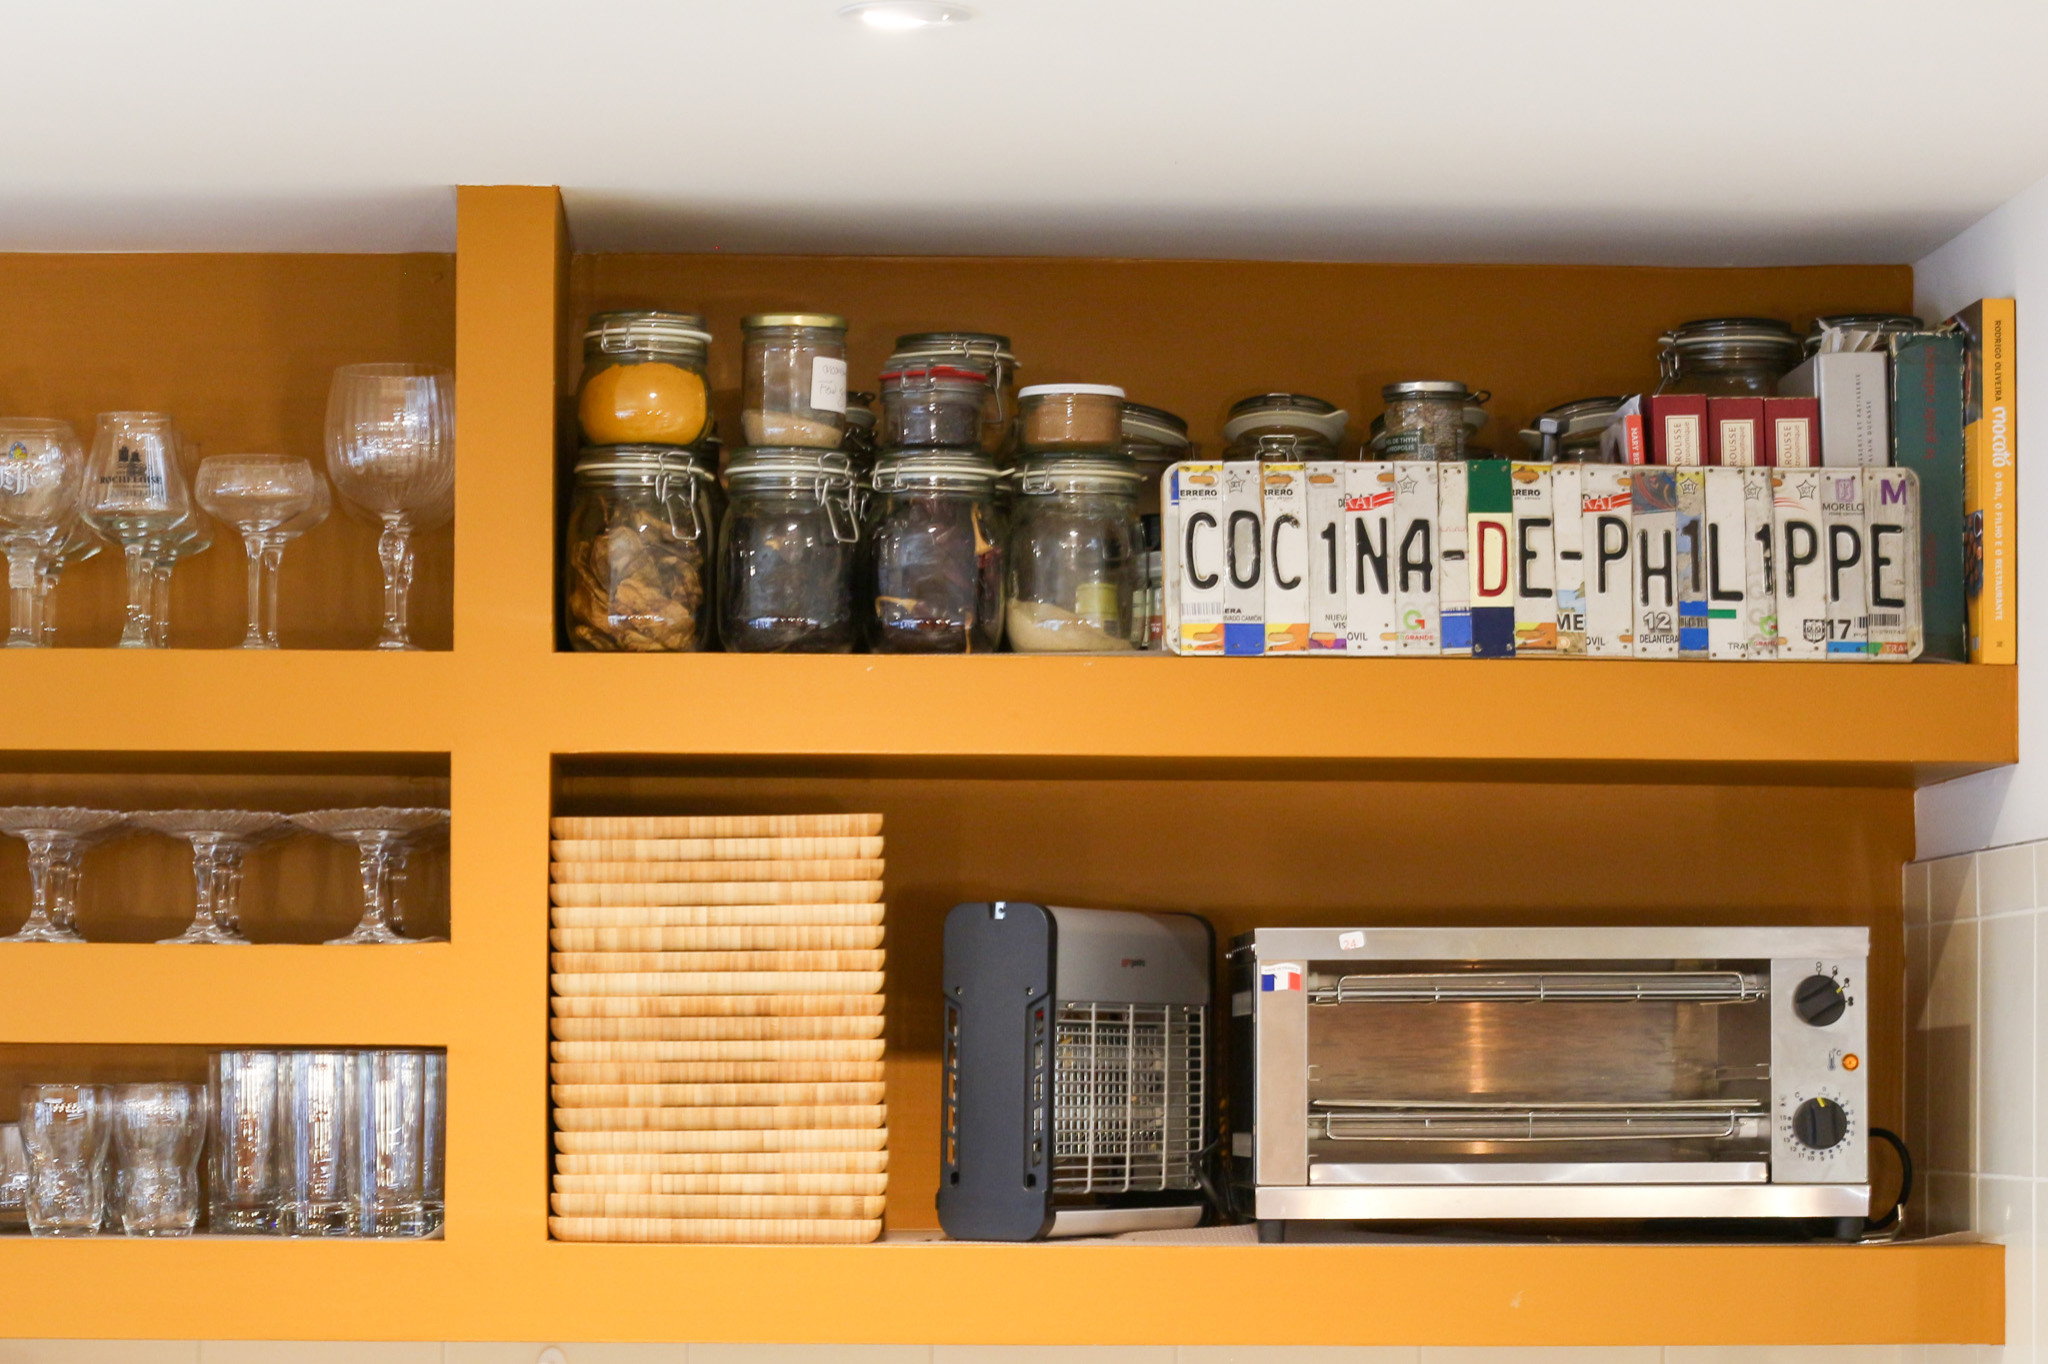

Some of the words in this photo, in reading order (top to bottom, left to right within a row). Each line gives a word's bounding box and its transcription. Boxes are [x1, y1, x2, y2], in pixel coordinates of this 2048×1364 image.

[1994, 361, 2002, 402] OLIVEIRA
[1631, 427, 1639, 451] MARY
[1180, 489, 1218, 497] ERRERO
[1995, 512, 2003, 539] FILHO
[1995, 558, 2003, 621] RESTAURANTE
[1643, 611, 1673, 632] 12
[1826, 619, 1852, 640] 17
